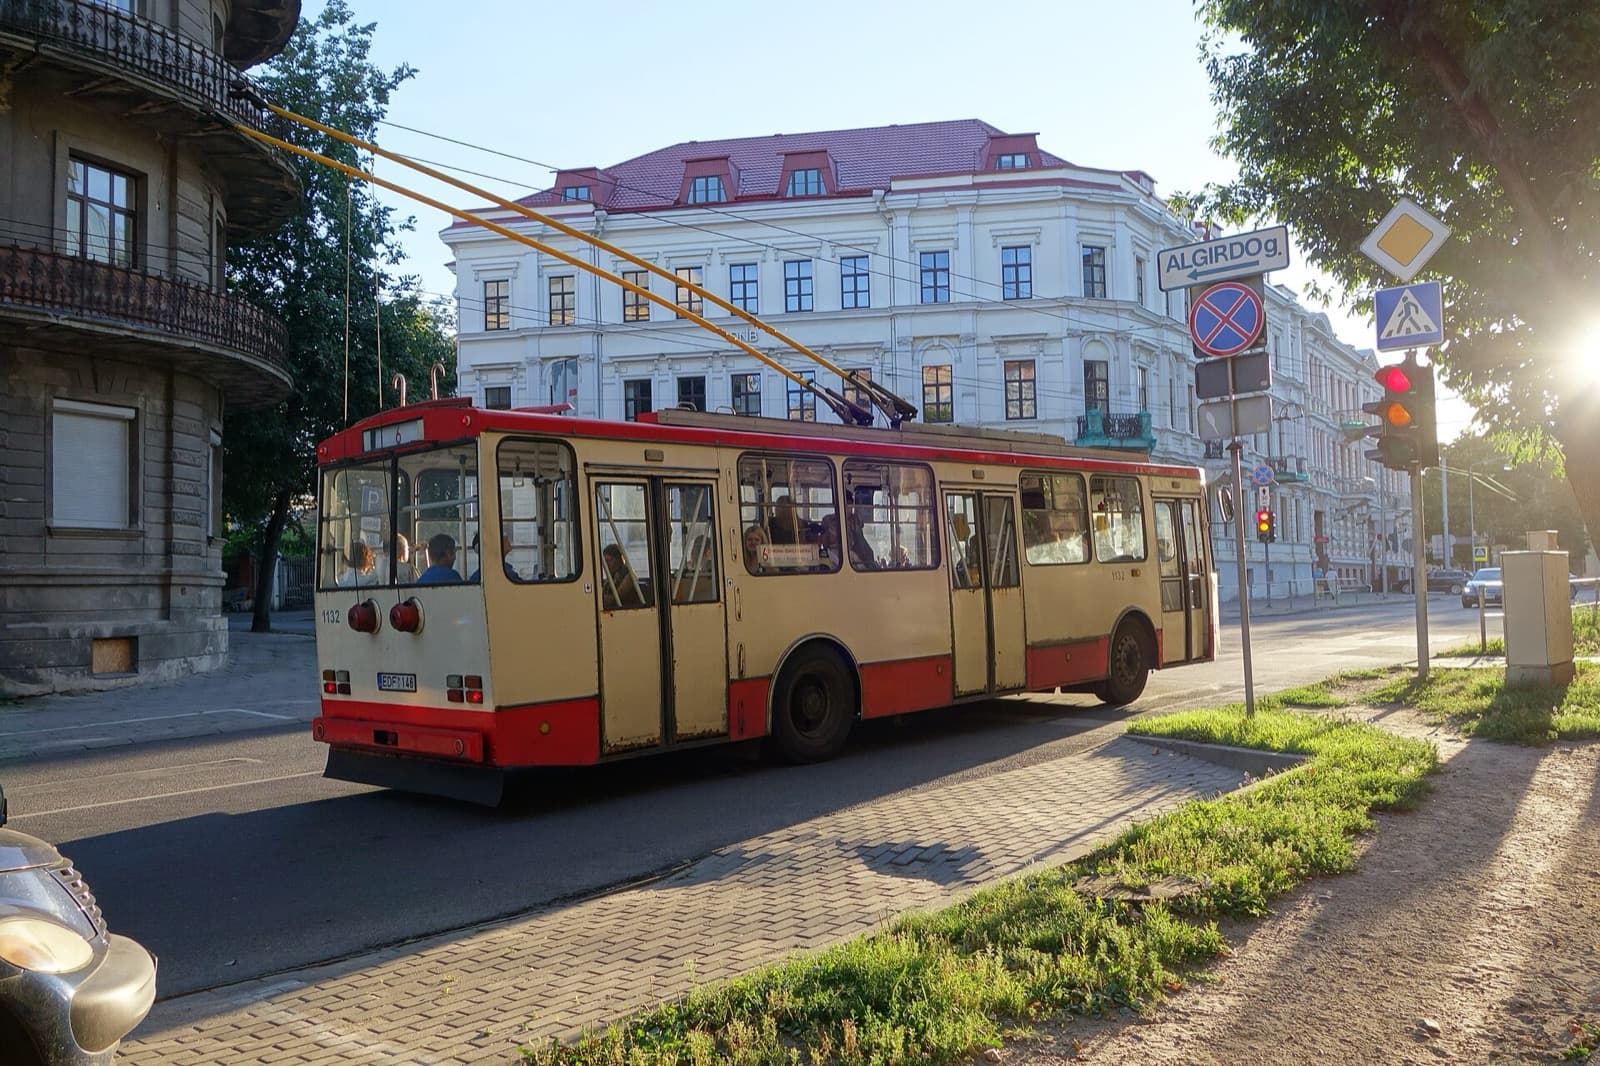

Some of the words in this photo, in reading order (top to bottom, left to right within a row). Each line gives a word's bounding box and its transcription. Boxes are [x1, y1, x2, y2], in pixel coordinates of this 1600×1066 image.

[1166, 238, 1263, 272] ALGIRDO
[395, 424, 403, 445] 6
[367, 490, 380, 512] P
[761, 547, 769, 562] 6
[320, 609, 341, 625] 1132
